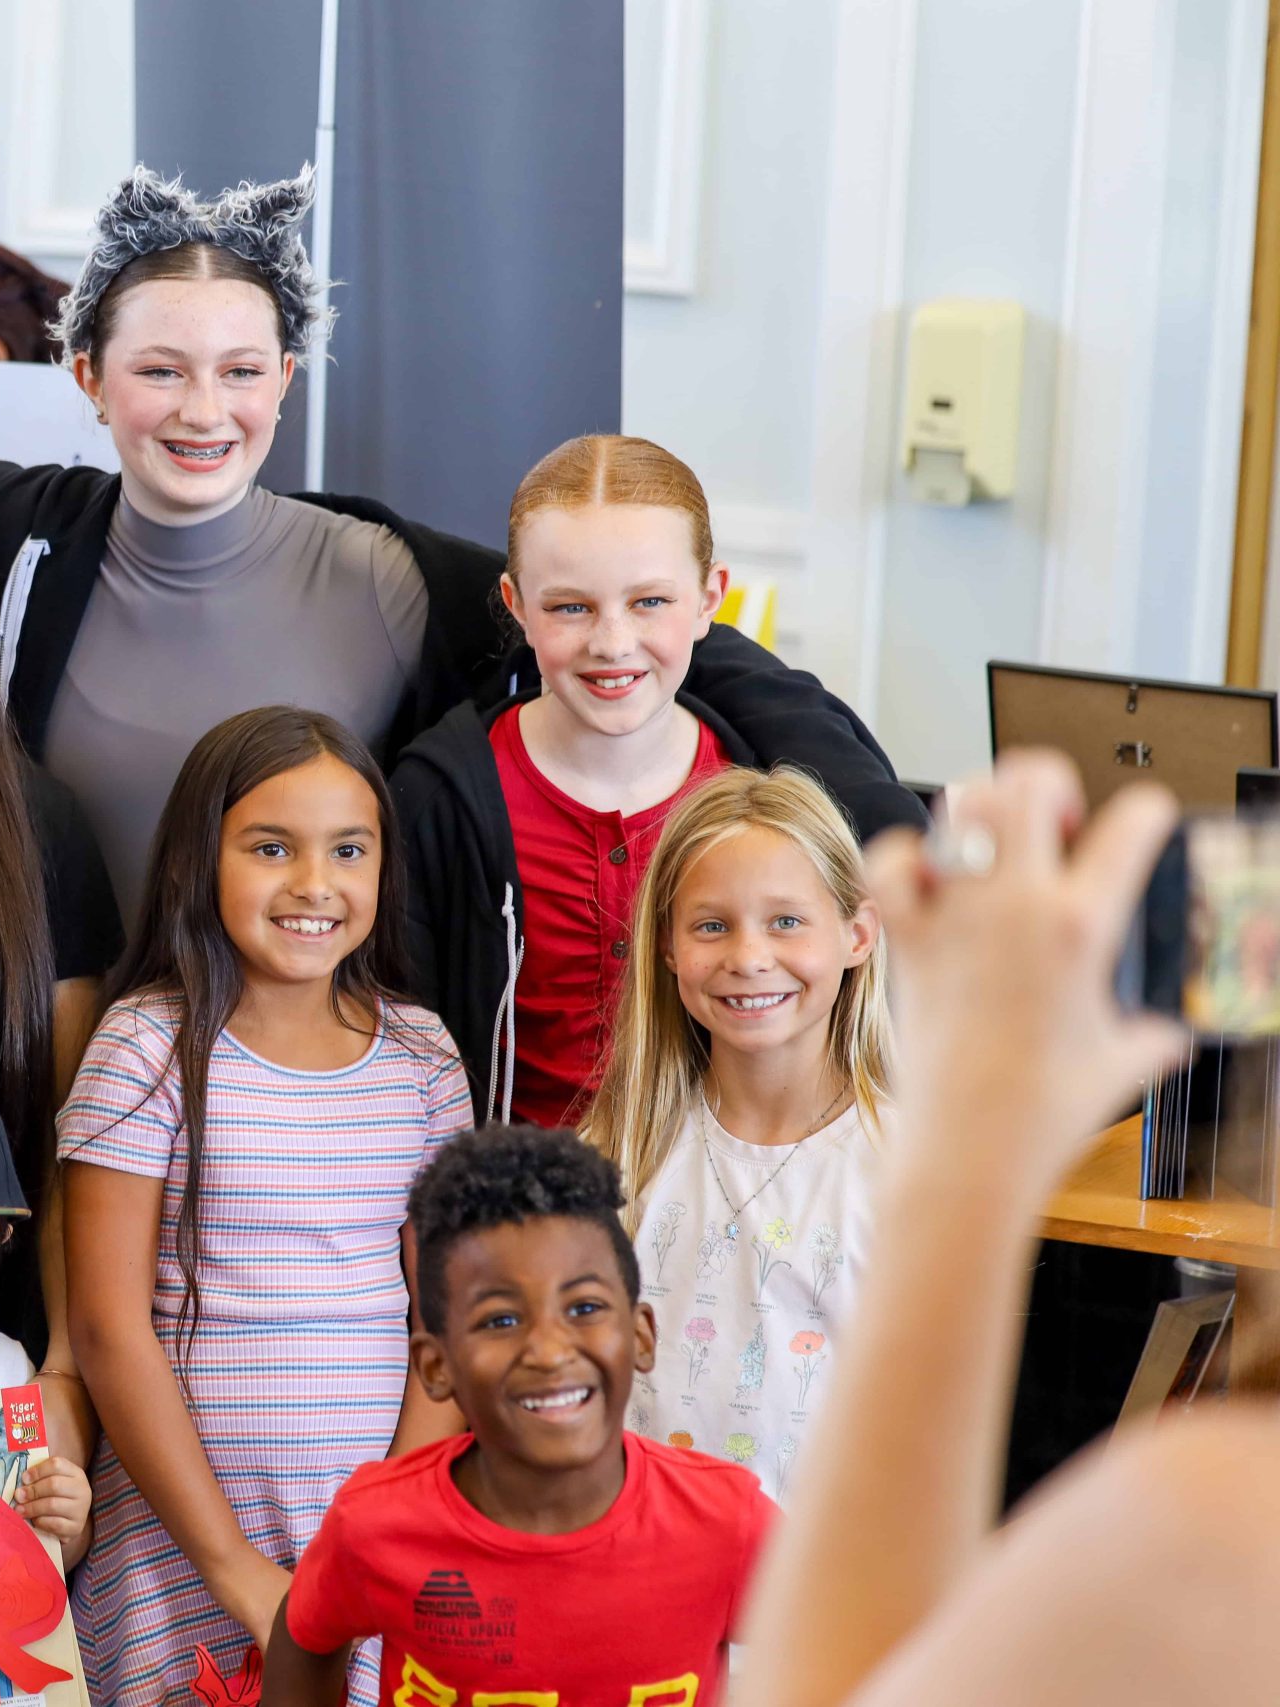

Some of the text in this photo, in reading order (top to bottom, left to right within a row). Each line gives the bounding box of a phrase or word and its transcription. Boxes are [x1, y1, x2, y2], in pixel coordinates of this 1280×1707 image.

[10, 1402, 35, 1414] tiger
[12, 1412, 36, 1424] tales
[415, 1618, 515, 1638] OFFICIAL UPDATE
